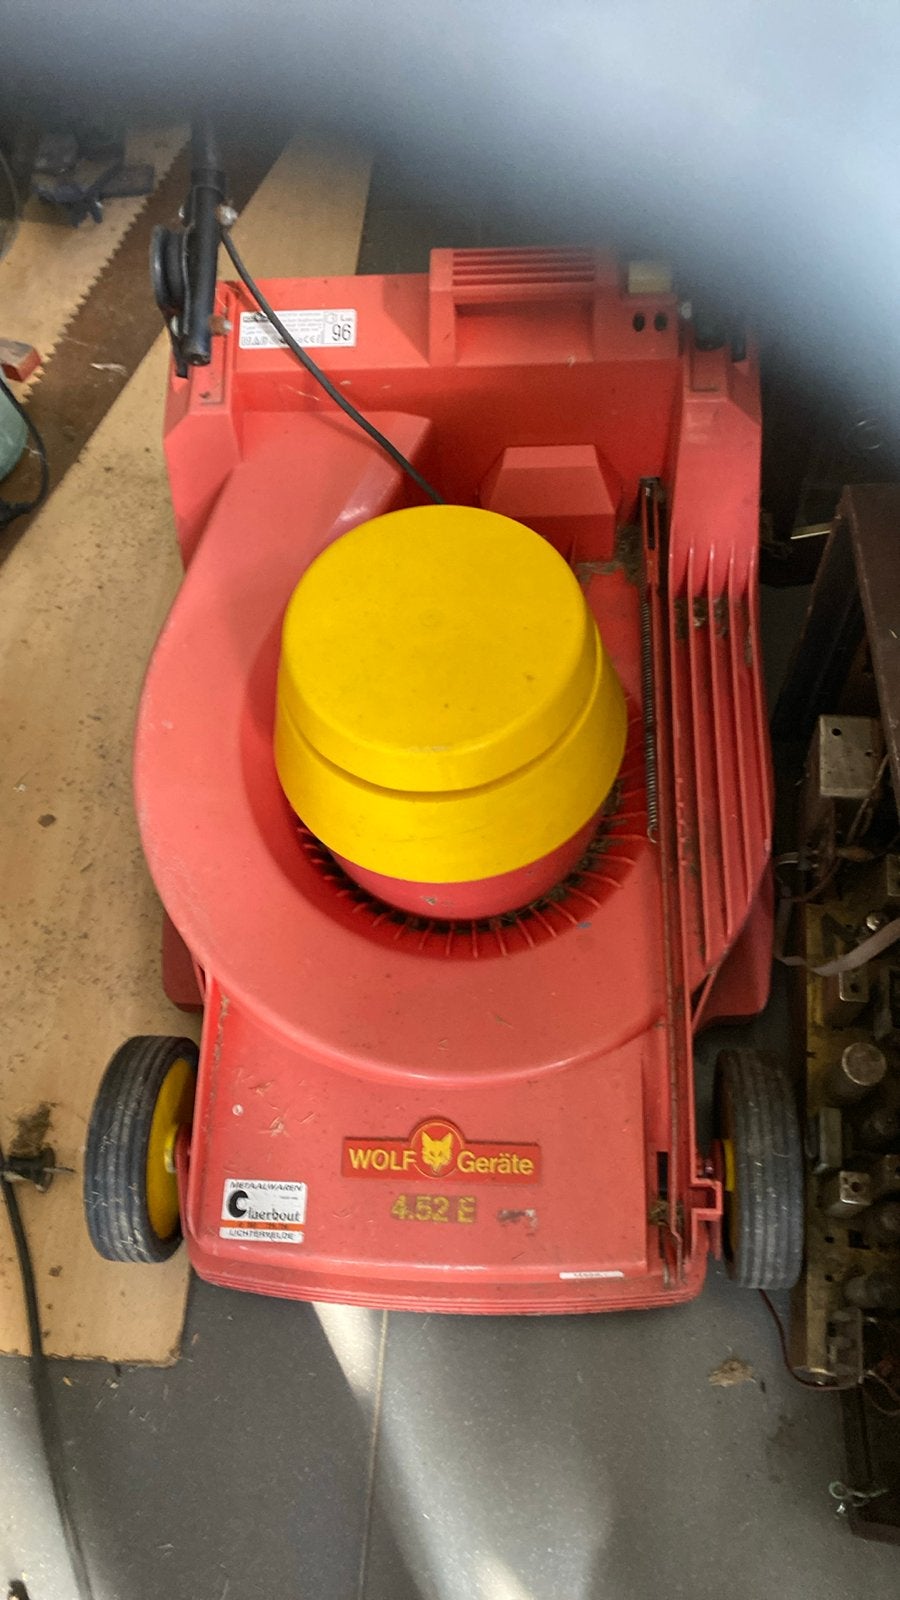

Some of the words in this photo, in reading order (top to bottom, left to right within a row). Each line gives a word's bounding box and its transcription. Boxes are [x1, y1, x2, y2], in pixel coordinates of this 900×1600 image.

[332, 323, 351, 342] 96
[349, 1148, 417, 1171] WOLF
[457, 1151, 534, 1176] Geräte
[230, 1181, 303, 1192] METAALWAREN
[228, 1190, 301, 1222] Claerbout
[391, 1195, 449, 1221] 4.52
[457, 1197, 476, 1223] E
[229, 1230, 294, 1240] LICHTERVELDE
